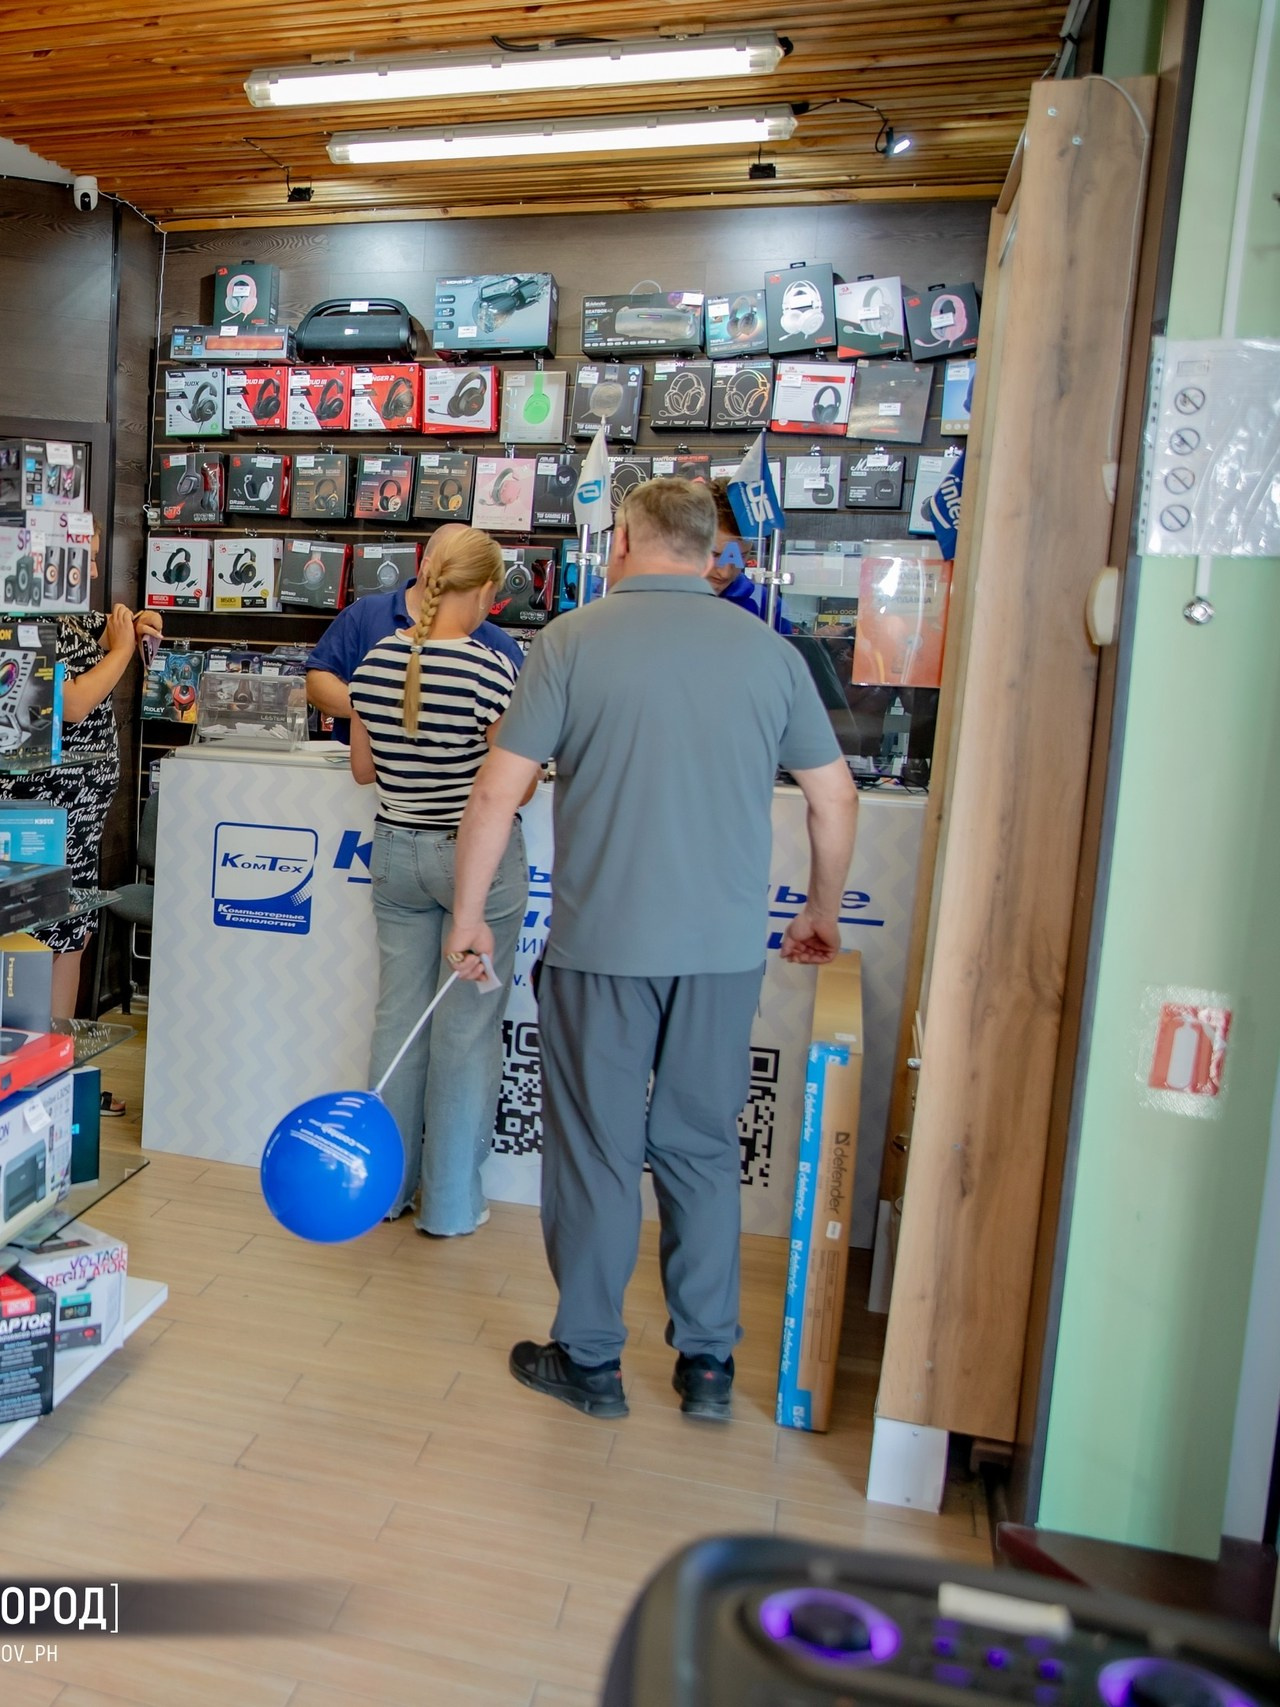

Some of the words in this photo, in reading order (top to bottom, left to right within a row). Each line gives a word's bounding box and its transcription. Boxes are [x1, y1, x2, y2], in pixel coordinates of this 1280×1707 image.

[789, 462, 836, 475] Marshall
[218, 903, 305, 920] Компьютерные
[226, 912, 296, 928] Технологии
[829, 1148, 849, 1214] defender
[795, 1171, 809, 1220] defender
[45, 1261, 127, 1288] REGULATOR
[787, 1250, 801, 1297] defender
